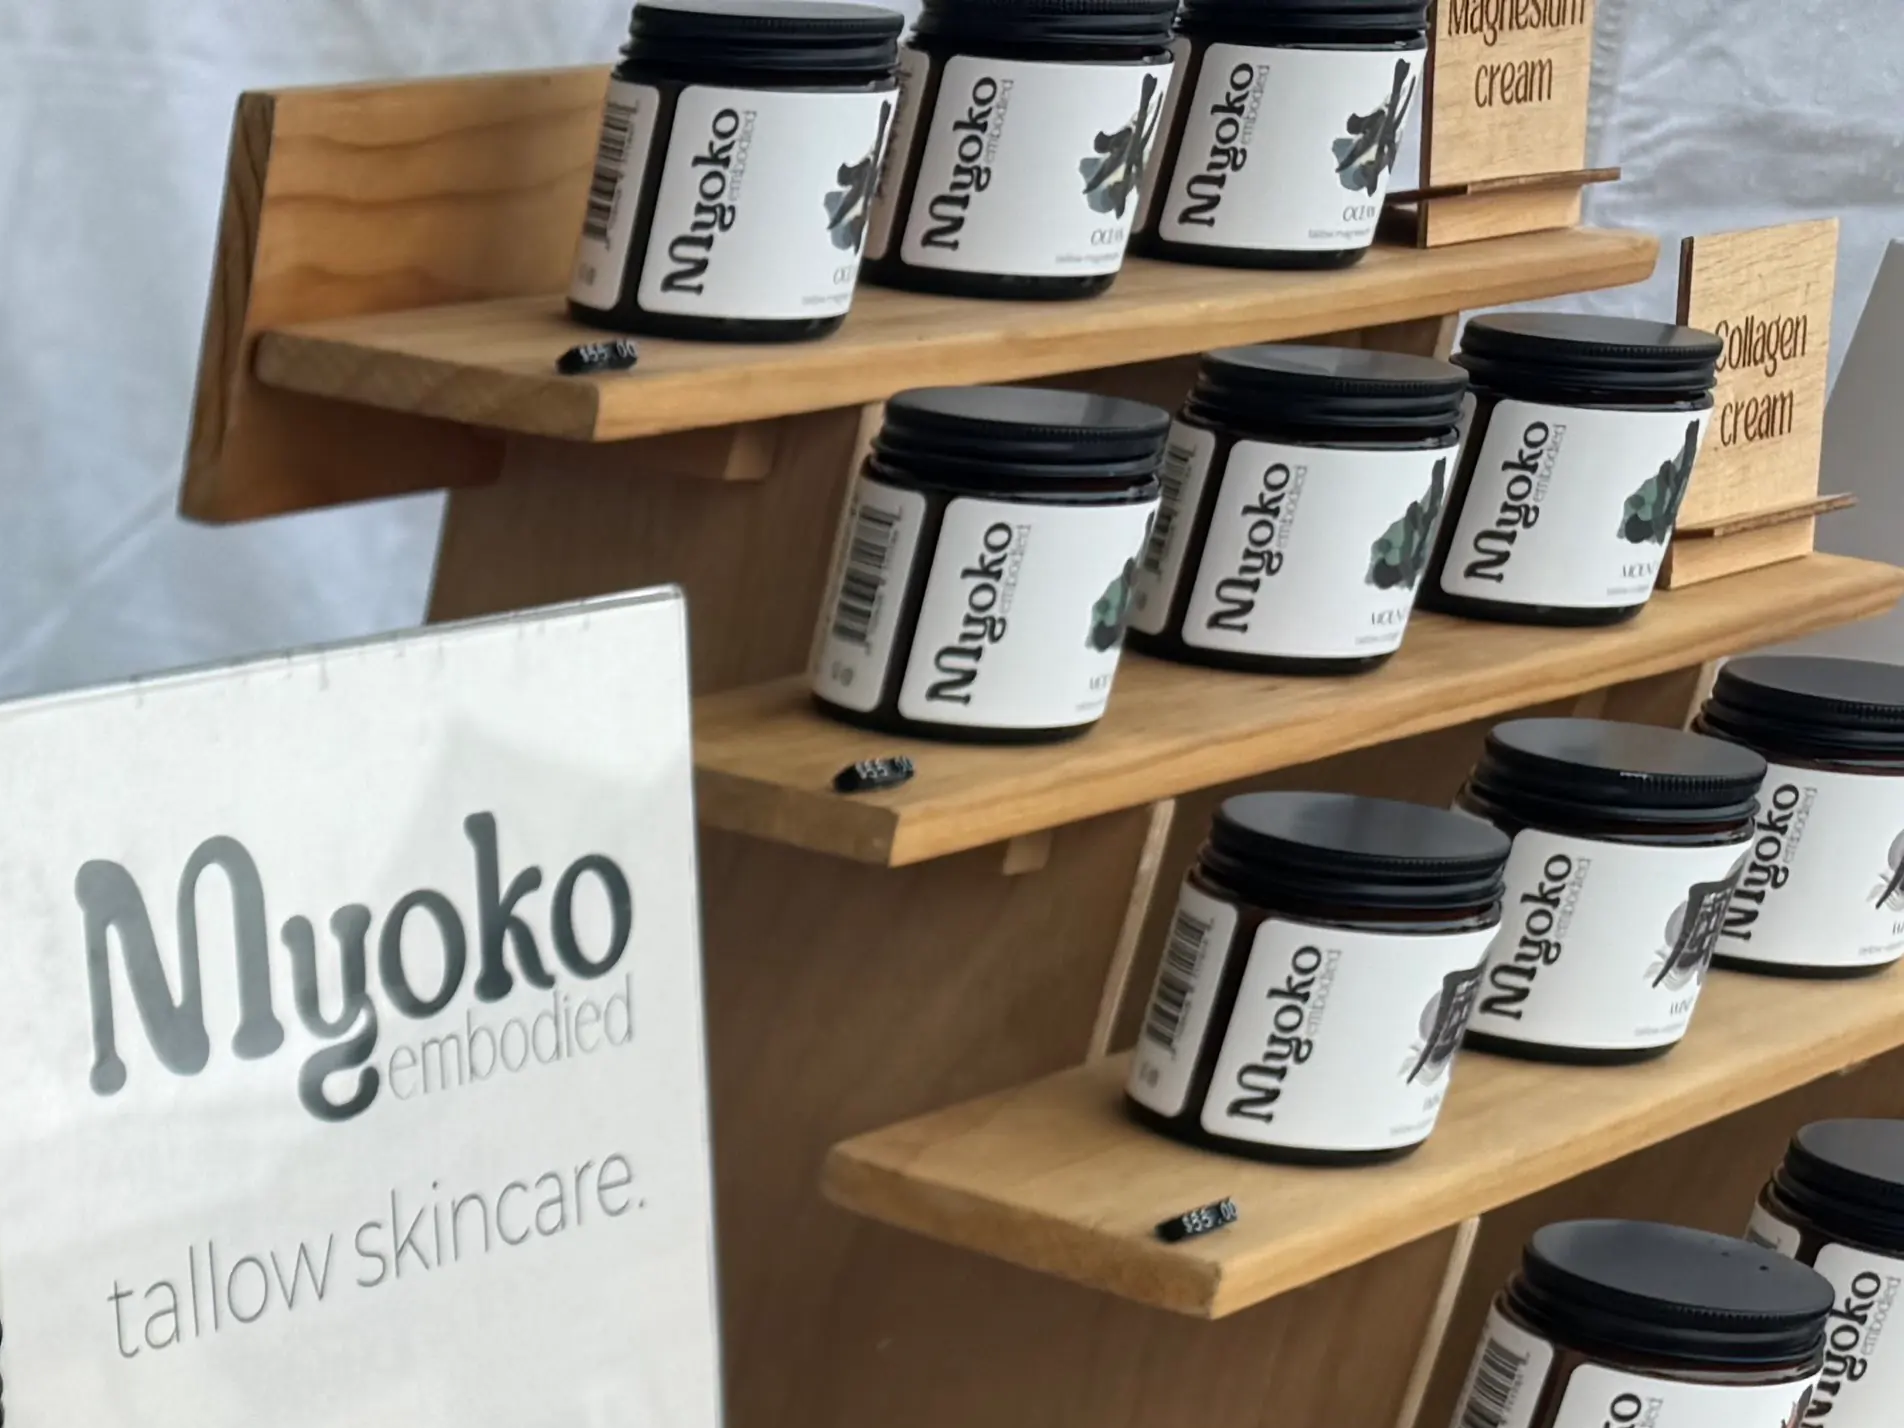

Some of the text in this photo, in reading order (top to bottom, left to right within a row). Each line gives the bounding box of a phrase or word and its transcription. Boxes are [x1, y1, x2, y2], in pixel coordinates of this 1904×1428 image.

[921, 76, 1000, 252] Myoko
[1178, 62, 1255, 228] Myoko
[1475, 58, 1553, 108] cream
[661, 108, 741, 296] Myoko
[1715, 313, 1808, 377] Collagen
[1721, 390, 1794, 447] cream
[1207, 462, 1290, 634] Myoko
[1464, 421, 1549, 583] Myoko
[926, 522, 1012, 707] Myoko
[74, 811, 633, 1123] Myoko
[1479, 853, 1572, 1021] Myoko
[387, 973, 635, 1100] embodied
[1227, 945, 1322, 1125] Myoko
[108, 1152, 646, 1358] tallow skincare.
